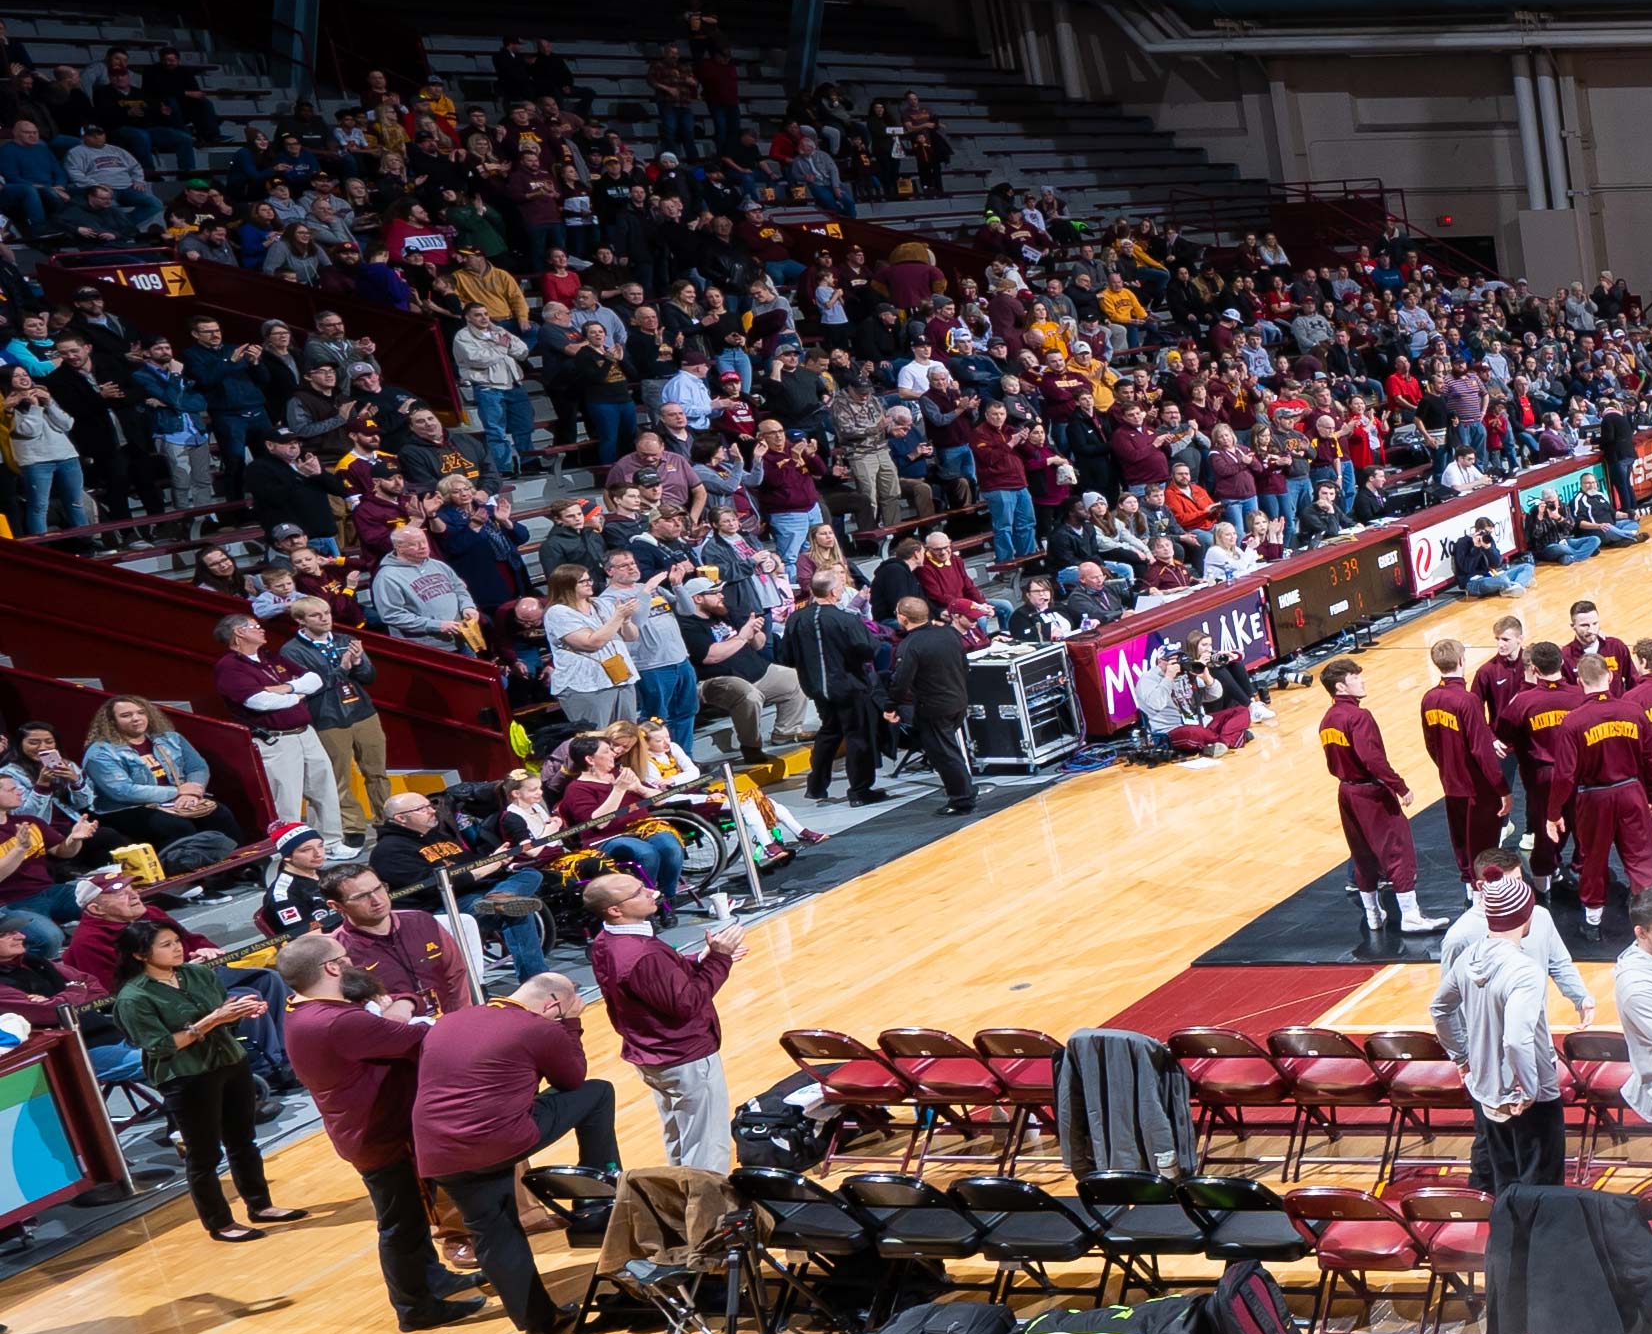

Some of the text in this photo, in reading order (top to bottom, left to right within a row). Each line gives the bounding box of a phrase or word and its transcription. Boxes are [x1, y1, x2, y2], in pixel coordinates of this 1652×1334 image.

[130, 274, 163, 290] 109
[1278, 589, 1301, 609] HOME
[1585, 721, 1639, 745] MINNESOTA
